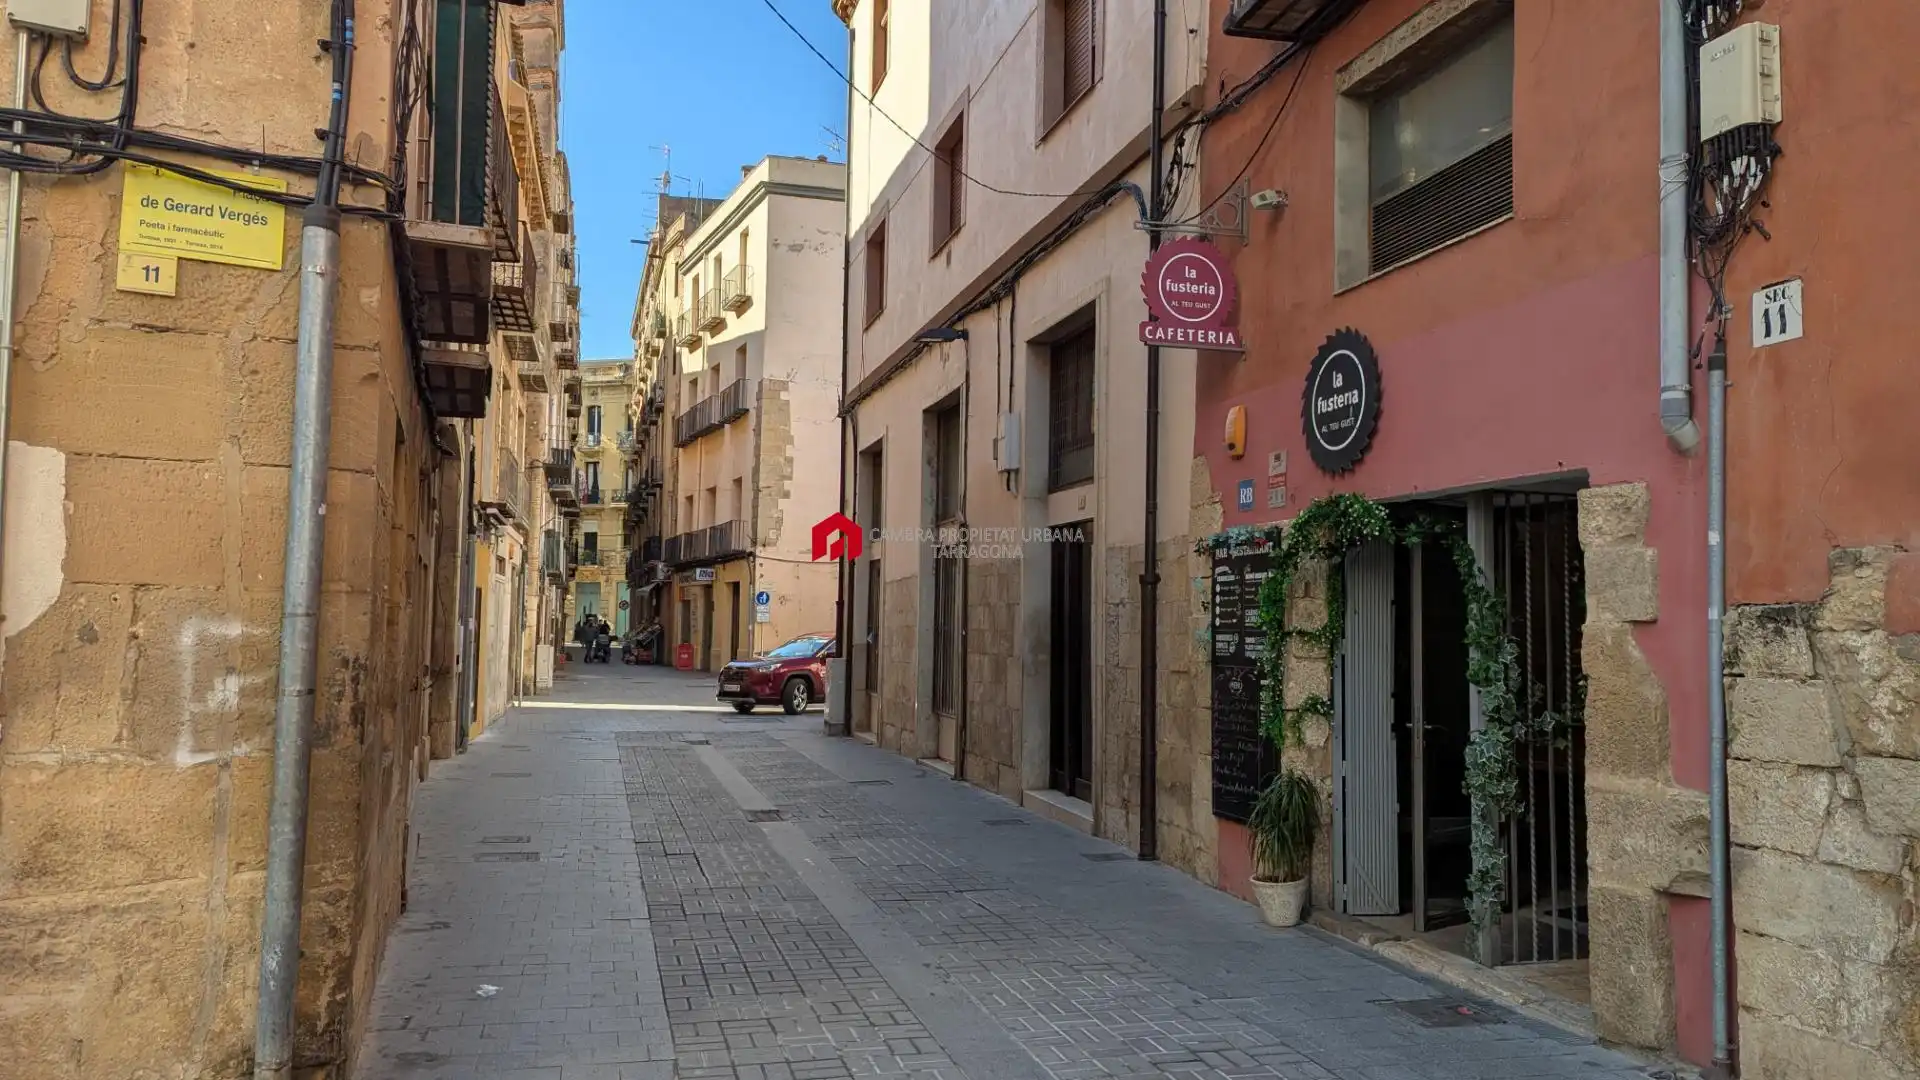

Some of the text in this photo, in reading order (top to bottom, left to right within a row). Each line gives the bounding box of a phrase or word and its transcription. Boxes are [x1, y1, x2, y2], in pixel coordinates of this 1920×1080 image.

[140, 195, 268, 226] de Gerard Vergés
[139, 219, 166, 231] Poeta
[141, 264, 160, 283] 11
[1185, 265, 1197, 279] la
[1166, 279, 1216, 295] fusteria
[1761, 303, 1787, 339] 11
[1144, 326, 1235, 344] CAFETERIA
[1332, 370, 1343, 389] la
[1317, 388, 1359, 415] fusteria
[1240, 487, 1253, 504] RB
